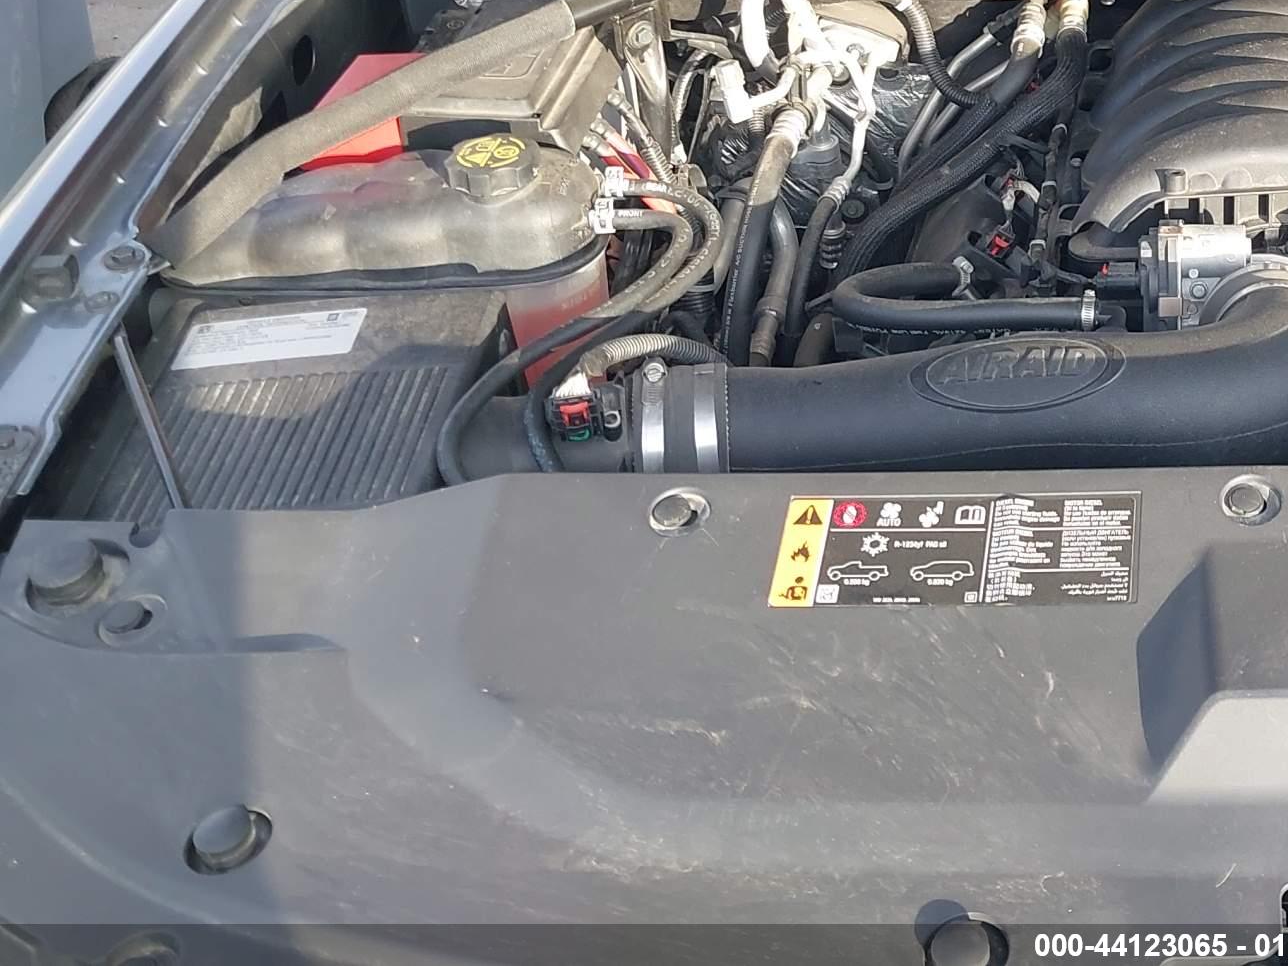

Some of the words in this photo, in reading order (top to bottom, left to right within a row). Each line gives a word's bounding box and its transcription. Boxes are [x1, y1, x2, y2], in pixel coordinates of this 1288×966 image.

[618, 210, 643, 218] FRONT
[938, 344, 1097, 386] AIRAID
[876, 518, 902, 527] AUTO
